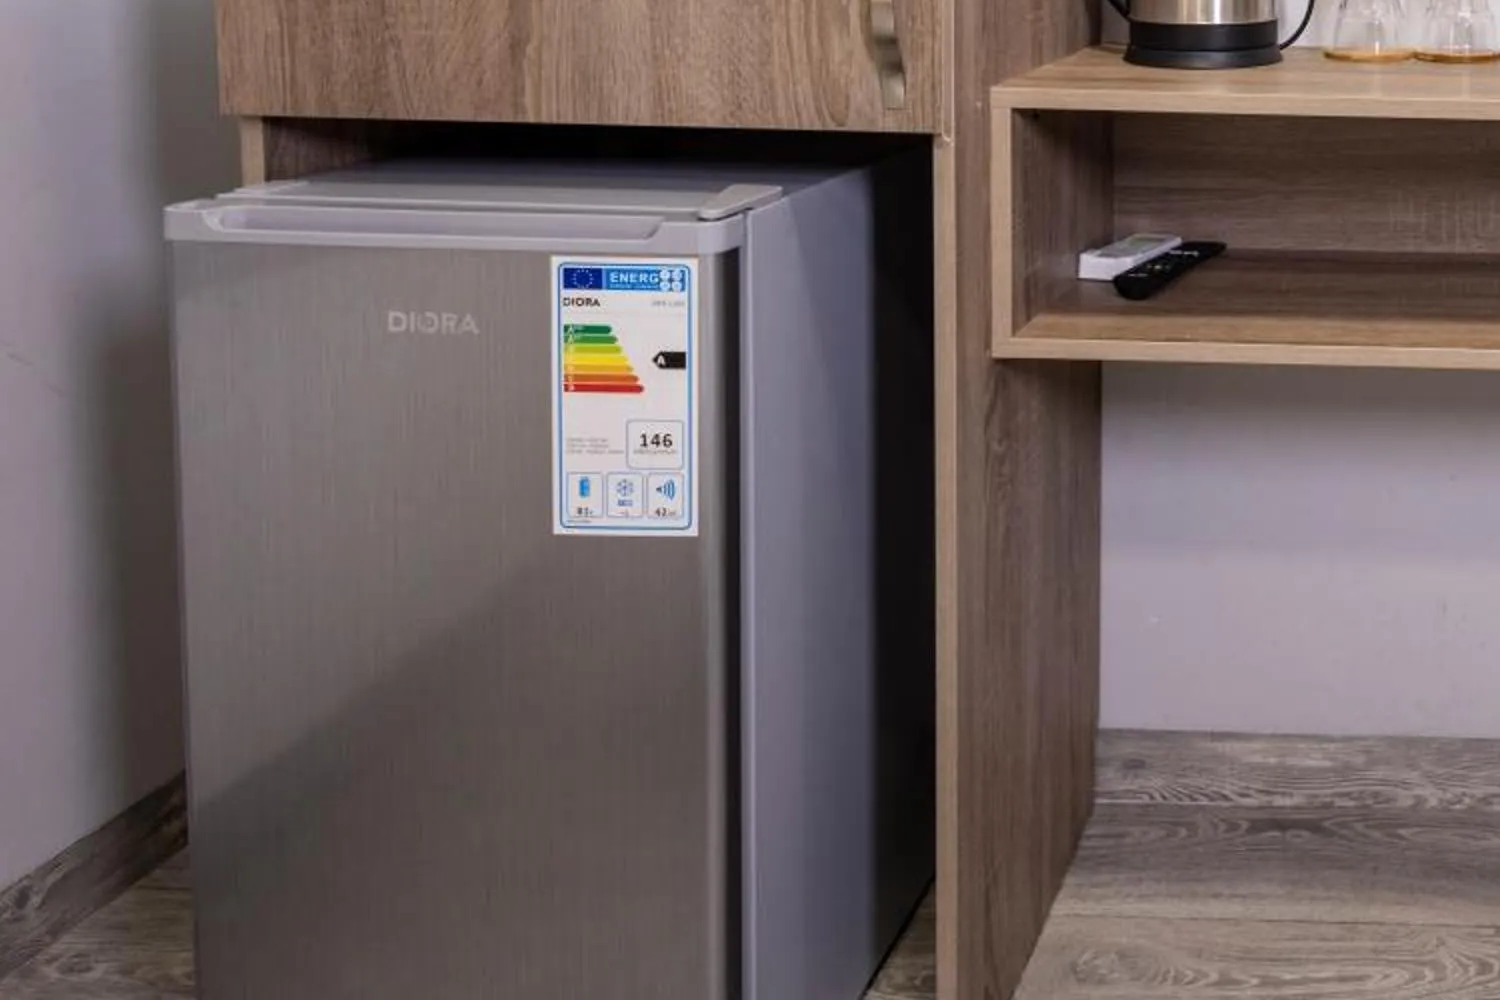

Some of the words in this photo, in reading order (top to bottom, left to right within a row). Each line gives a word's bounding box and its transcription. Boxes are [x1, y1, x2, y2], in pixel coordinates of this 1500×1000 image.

[609, 271, 659, 283] ENERG
[562, 297, 601, 307] DIORA
[387, 310, 480, 335] DIORA
[639, 433, 673, 448] 146
